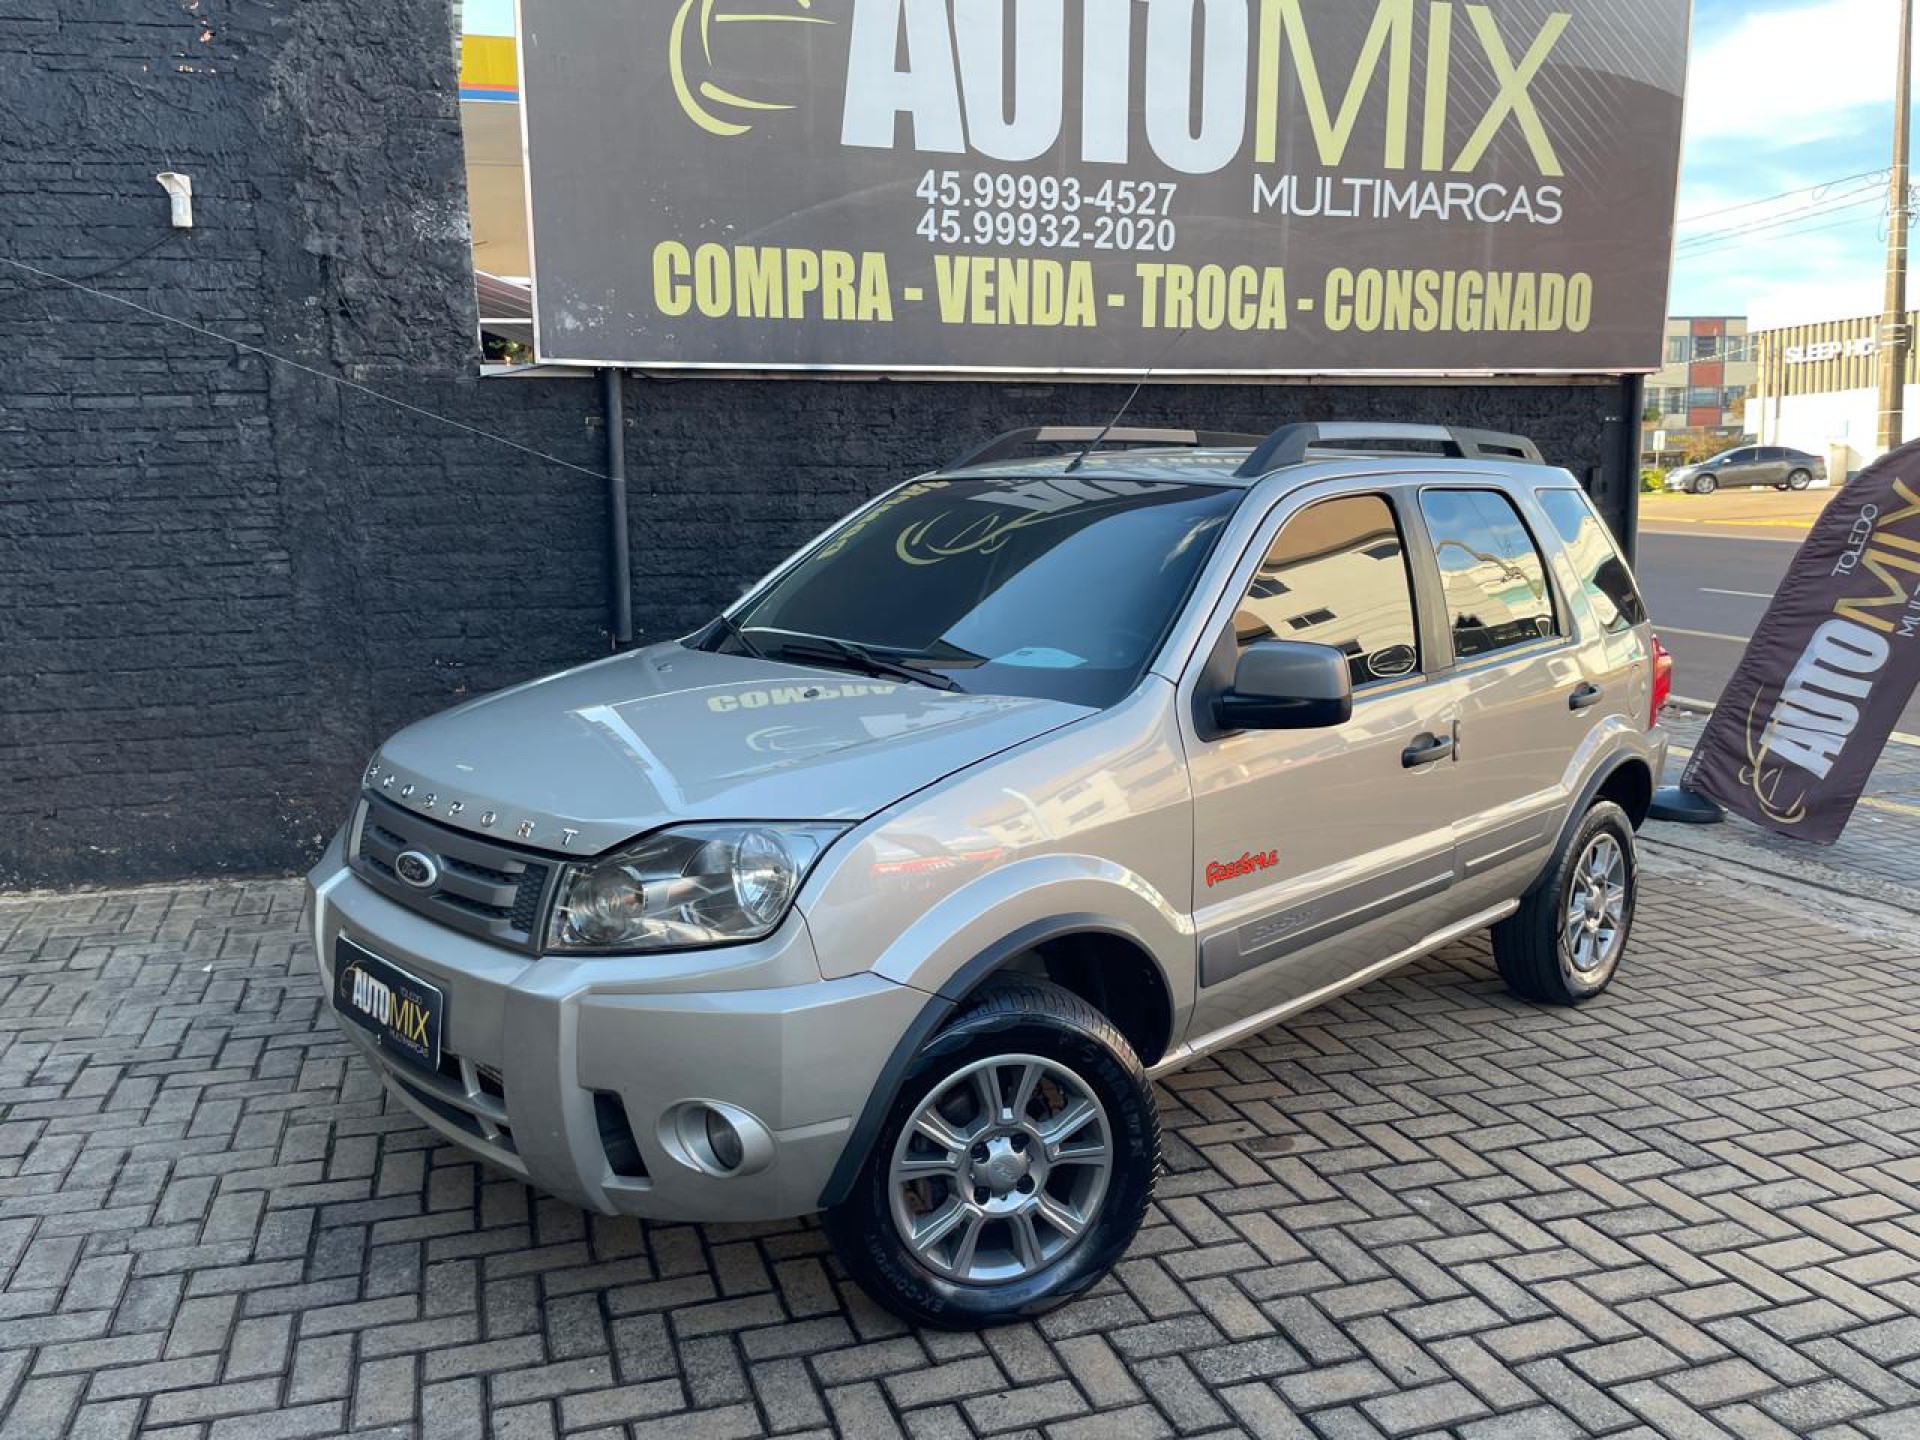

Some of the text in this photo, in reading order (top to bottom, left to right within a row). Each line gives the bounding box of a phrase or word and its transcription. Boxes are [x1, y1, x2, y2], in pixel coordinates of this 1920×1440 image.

[916, 168, 1177, 216] 45.99993-4527
[1253, 173, 1564, 225] MULTIMARCAS
[916, 209, 1176, 252] 45.99932-2020
[653, 240, 894, 323] COMPRA
[934, 254, 1098, 328] VENDA
[1136, 263, 1289, 332] TROCA
[1324, 267, 1594, 333] CONSIGNADO
[1831, 503, 1878, 577] TOLEDO
